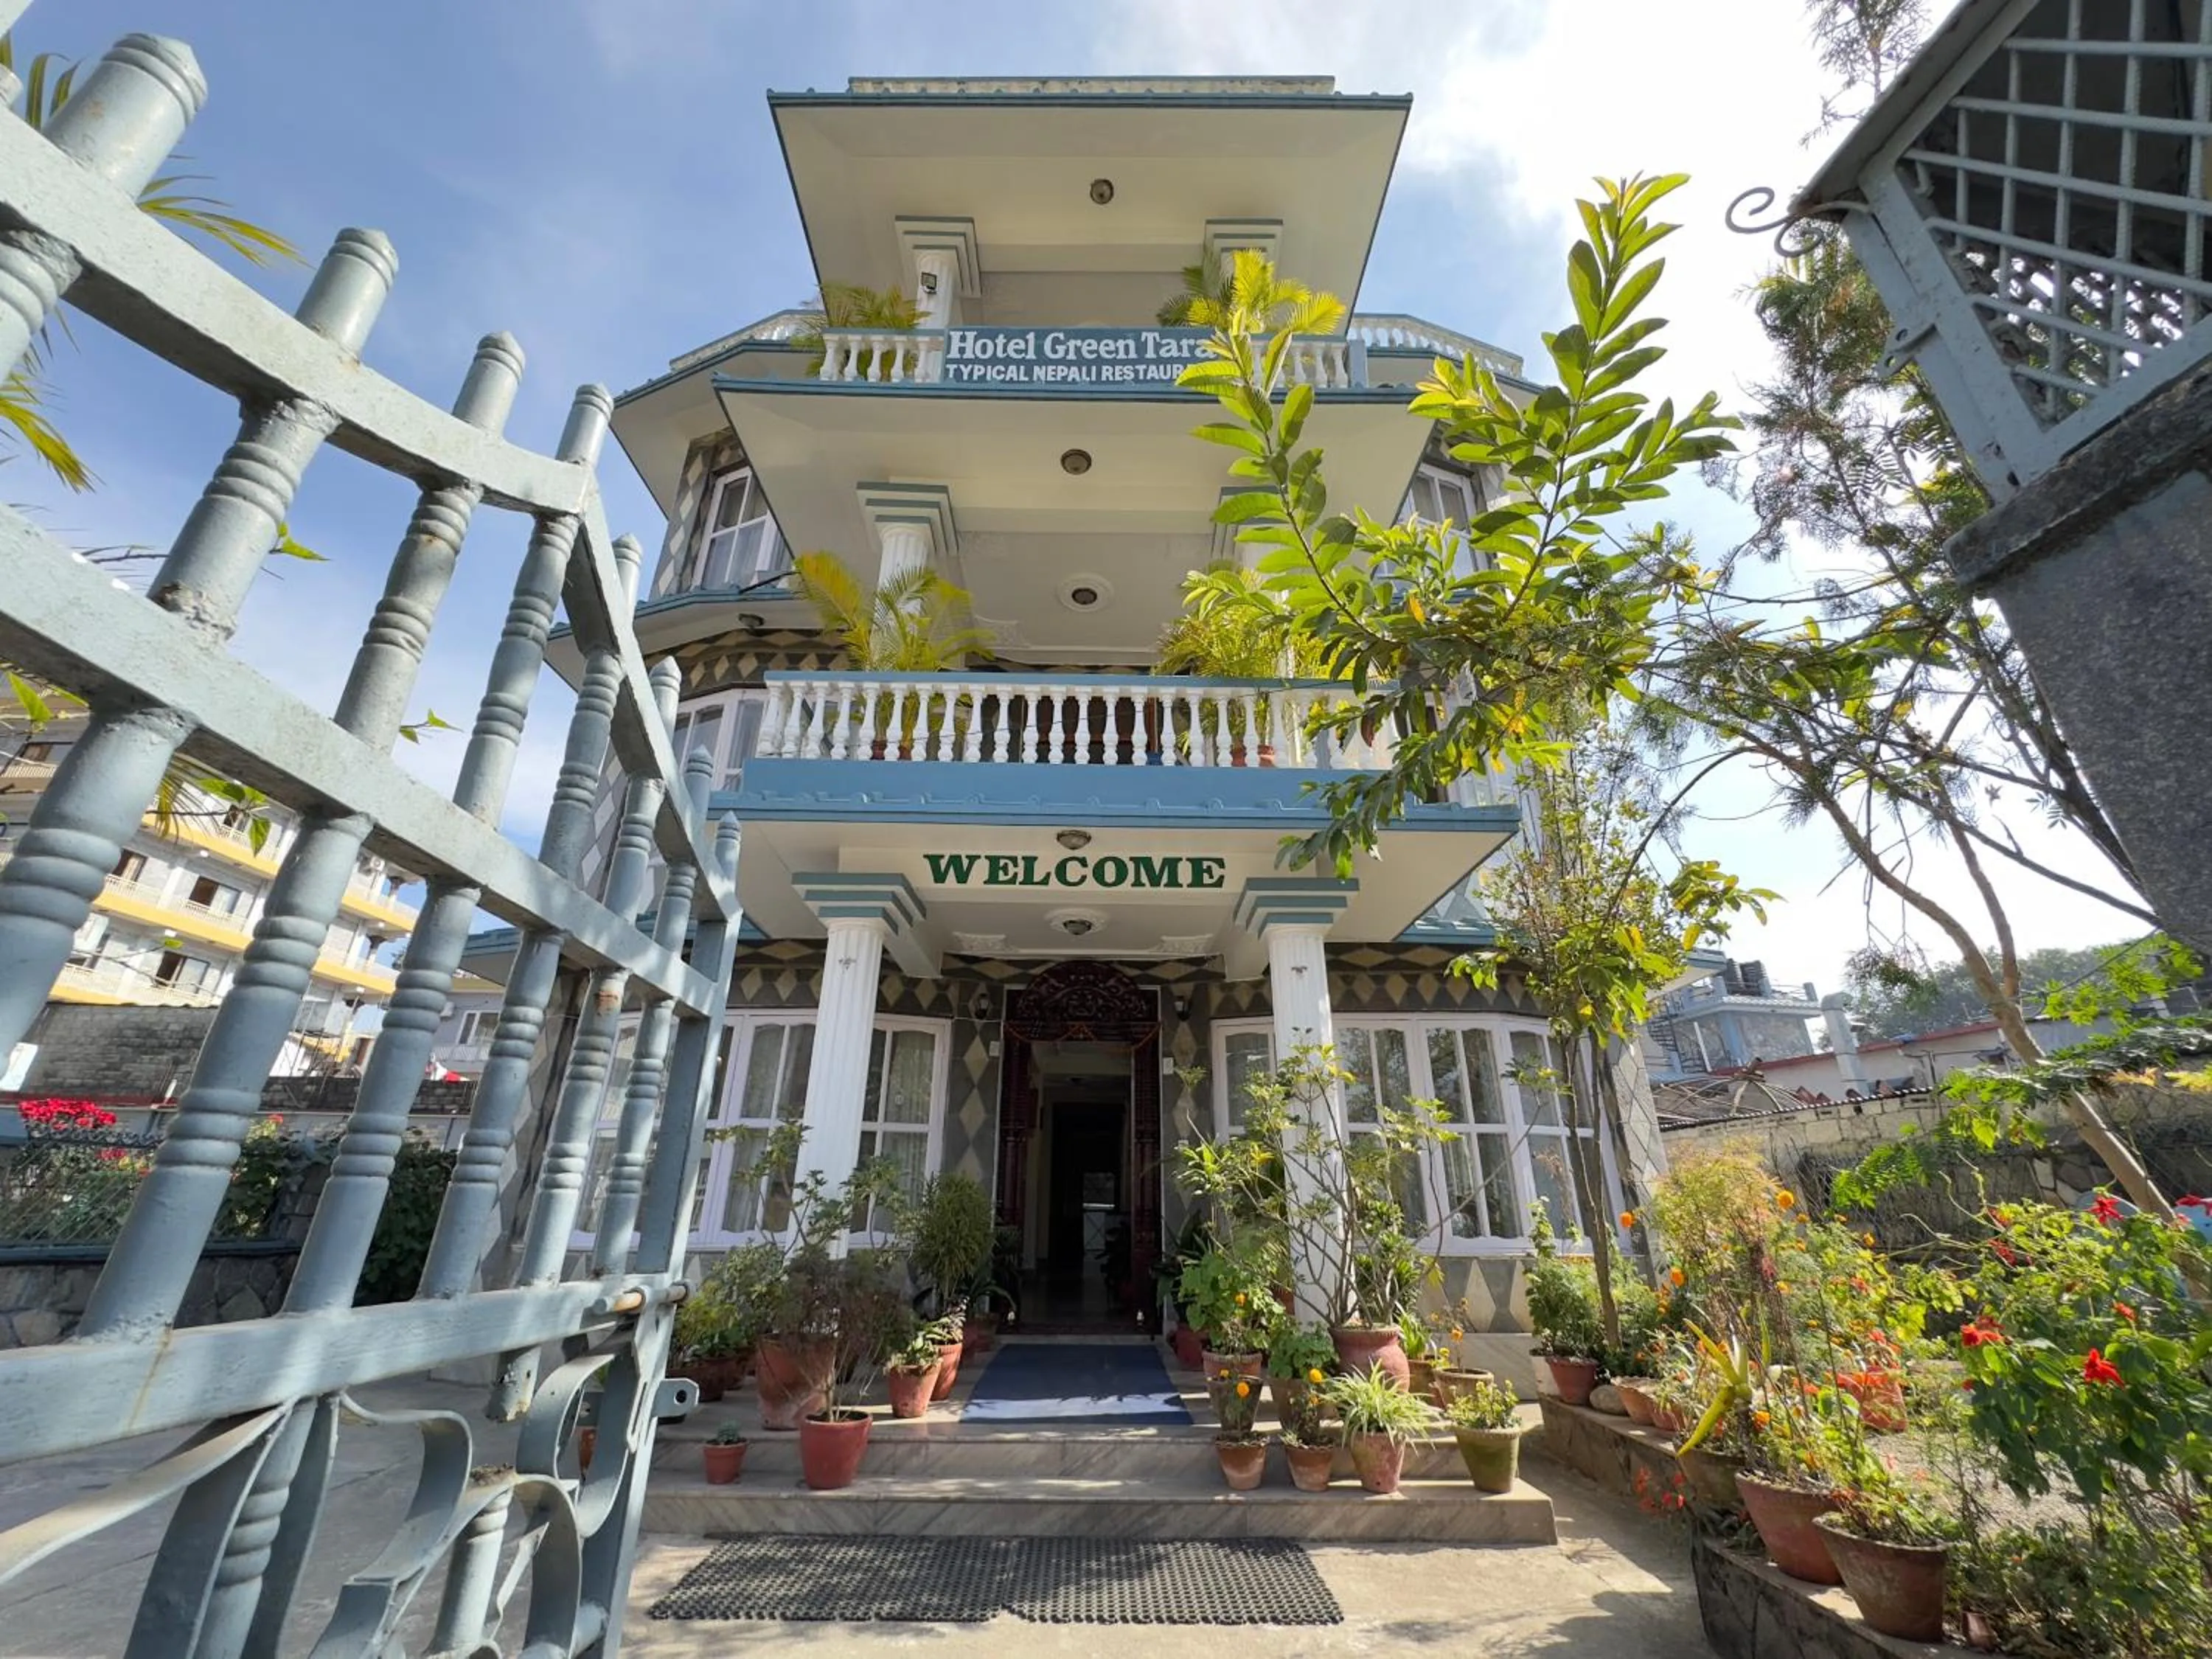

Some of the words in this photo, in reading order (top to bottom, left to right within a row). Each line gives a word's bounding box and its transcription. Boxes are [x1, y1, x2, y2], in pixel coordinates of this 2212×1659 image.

[947, 331, 1037, 360] Hotel
[1043, 332, 1138, 360] Green
[1141, 332, 1220, 359] Tara
[946, 364, 1029, 381] TYPICAL
[1033, 365, 1096, 381] NEPALI
[1102, 364, 1186, 380] RESTAUR
[923, 854, 1226, 888] WELCOME
